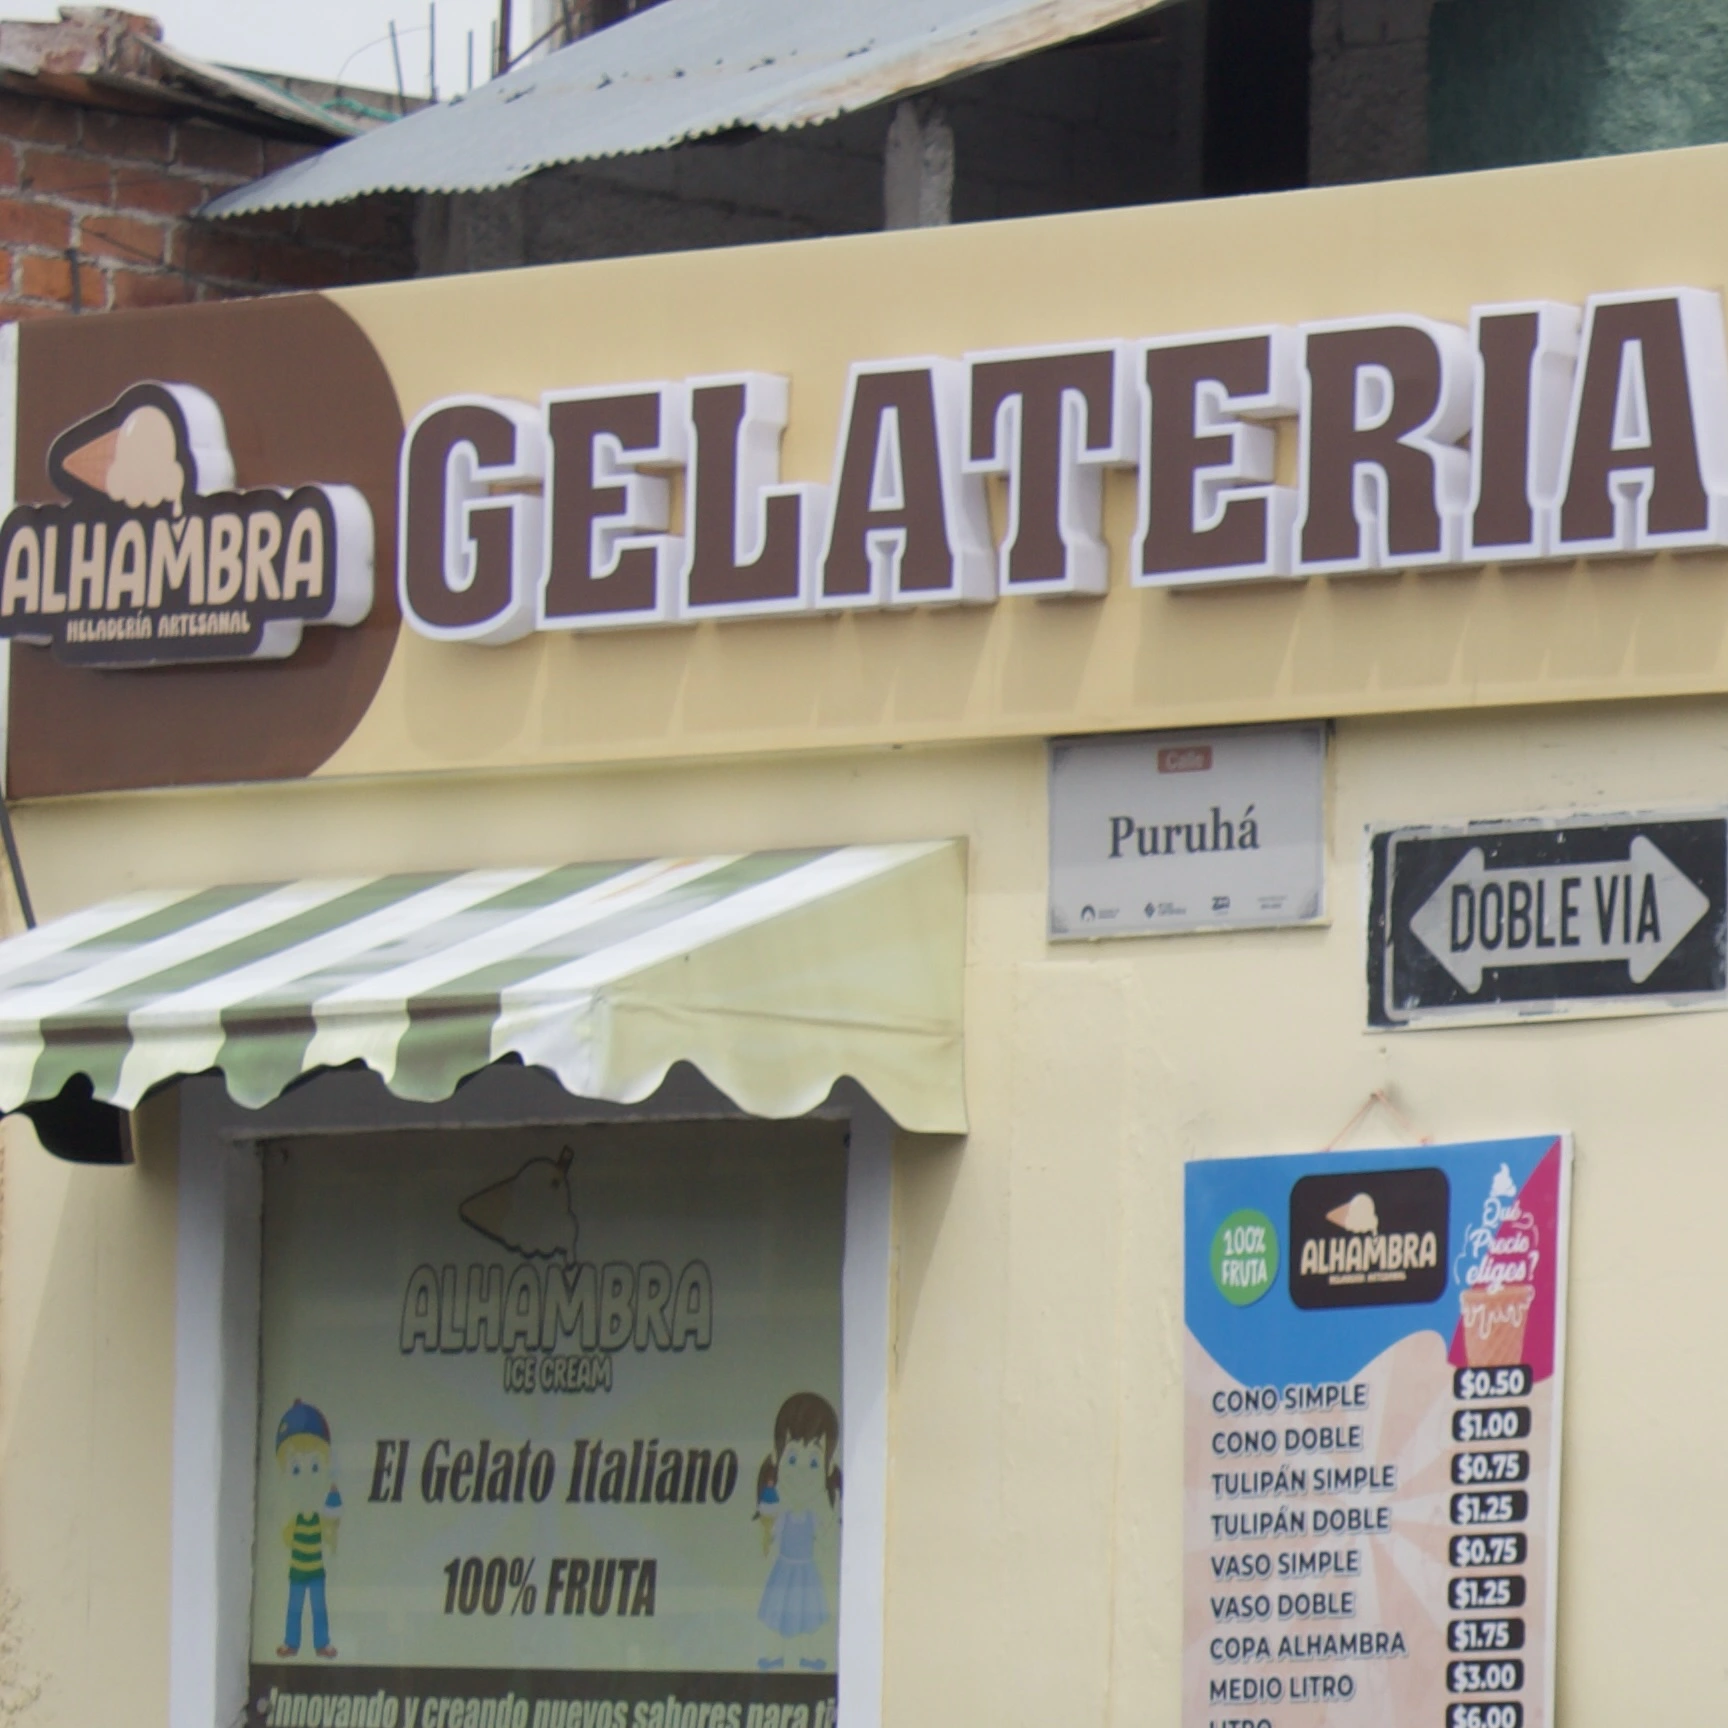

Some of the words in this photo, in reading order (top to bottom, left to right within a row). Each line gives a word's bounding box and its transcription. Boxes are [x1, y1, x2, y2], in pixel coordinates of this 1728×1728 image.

[404, 290, 1716, 642] GELATERIA
[1, 508, 323, 617] ALHAMBRA
[66, 609, 152, 643] HELADERÍA
[157, 610, 251, 639] ARTESANAL
[1108, 804, 1260, 859] Puruhá
[1450, 877, 1583, 954] DOBLE
[1595, 872, 1661, 945] VIA
[1222, 1226, 1266, 1256] 100%
[1301, 1231, 1437, 1276] ALHAMBRA
[1221, 1257, 1268, 1287] FRUTA
[401, 1260, 713, 1354] ALHAMBRA
[503, 1355, 536, 1393] ICE
[541, 1354, 613, 1393] CREAM
[1460, 1369, 1525, 1398] $0.50
[1212, 1389, 1277, 1413] CONO
[1284, 1384, 1368, 1409] SIMPLE
[1212, 1430, 1277, 1454] CONO
[1284, 1426, 1361, 1450] DOBLE
[1458, 1411, 1519, 1441] $1.00
[368, 1439, 408, 1503] El
[421, 1439, 556, 1503] Gelato
[565, 1438, 739, 1504] Italiano
[1212, 1465, 1307, 1496] TULIPÁN
[1313, 1465, 1395, 1491] SIMPLE
[1458, 1453, 1520, 1483] $0.75
[1211, 1506, 1305, 1537] TULIPÁN
[1313, 1507, 1389, 1532] DOBLE
[1457, 1494, 1513, 1524] $1.25
[1211, 1553, 1271, 1577] VASO
[1278, 1550, 1359, 1575] SIMPLE
[1456, 1537, 1518, 1567] $0.75
[443, 1556, 537, 1617] 100%
[546, 1558, 657, 1617] FRUTA
[1455, 1579, 1511, 1609] $1.25
[1210, 1595, 1271, 1618] VASO
[1278, 1592, 1353, 1615] DOBLE
[1210, 1637, 1271, 1660] COPA
[1278, 1631, 1406, 1657] ALHAMBRA
[1455, 1621, 1510, 1651] $1.75
[1210, 1678, 1283, 1700] MEDIO
[1290, 1675, 1354, 1698] LITRO
[1453, 1663, 1516, 1692] $3.00
